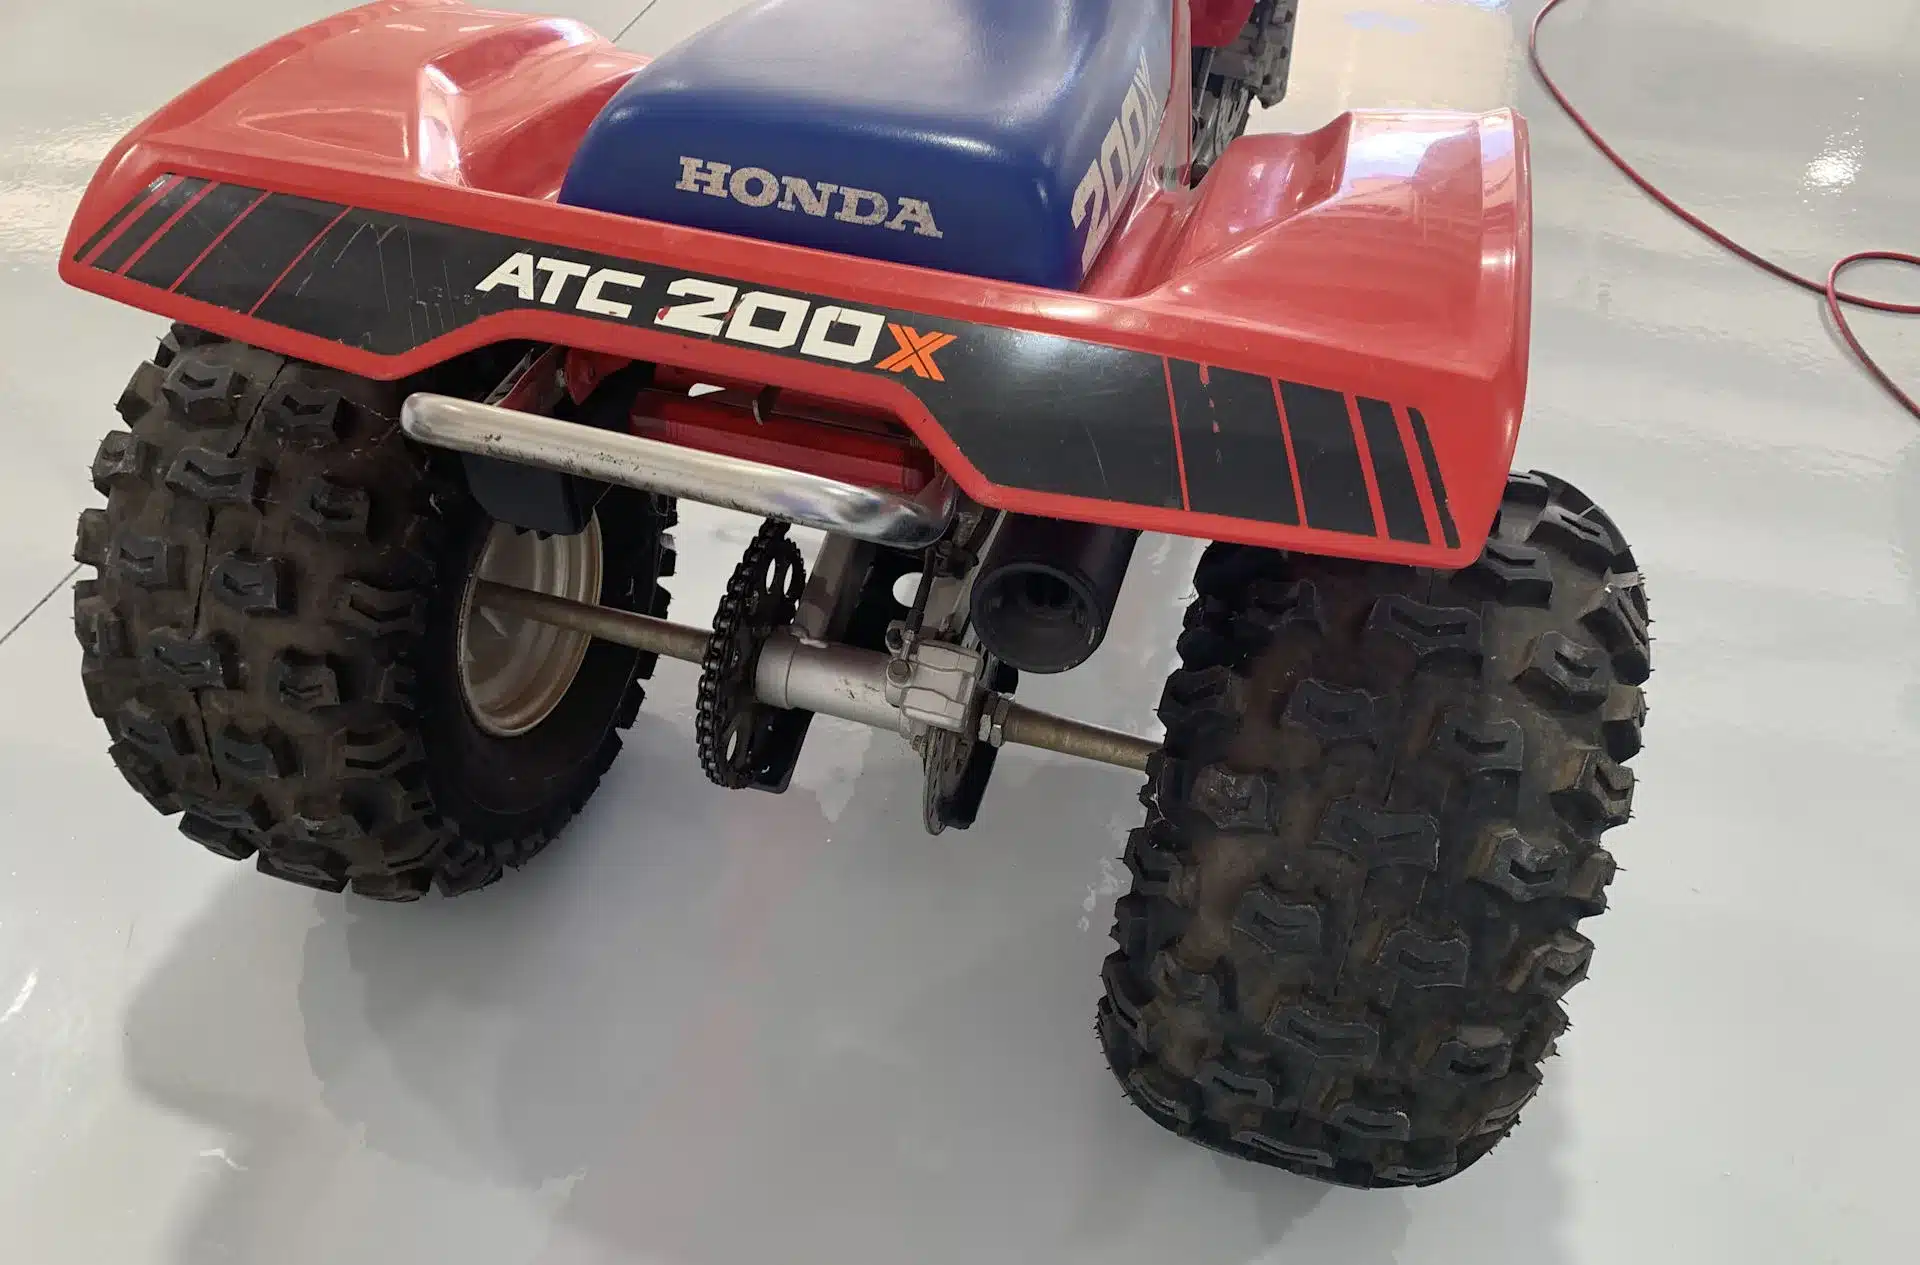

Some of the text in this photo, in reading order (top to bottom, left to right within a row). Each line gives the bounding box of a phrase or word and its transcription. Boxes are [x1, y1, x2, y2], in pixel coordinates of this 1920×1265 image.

[675, 155, 944, 239] HONDA
[1070, 46, 1158, 278] 200X
[475, 251, 958, 382] ATC 200X
